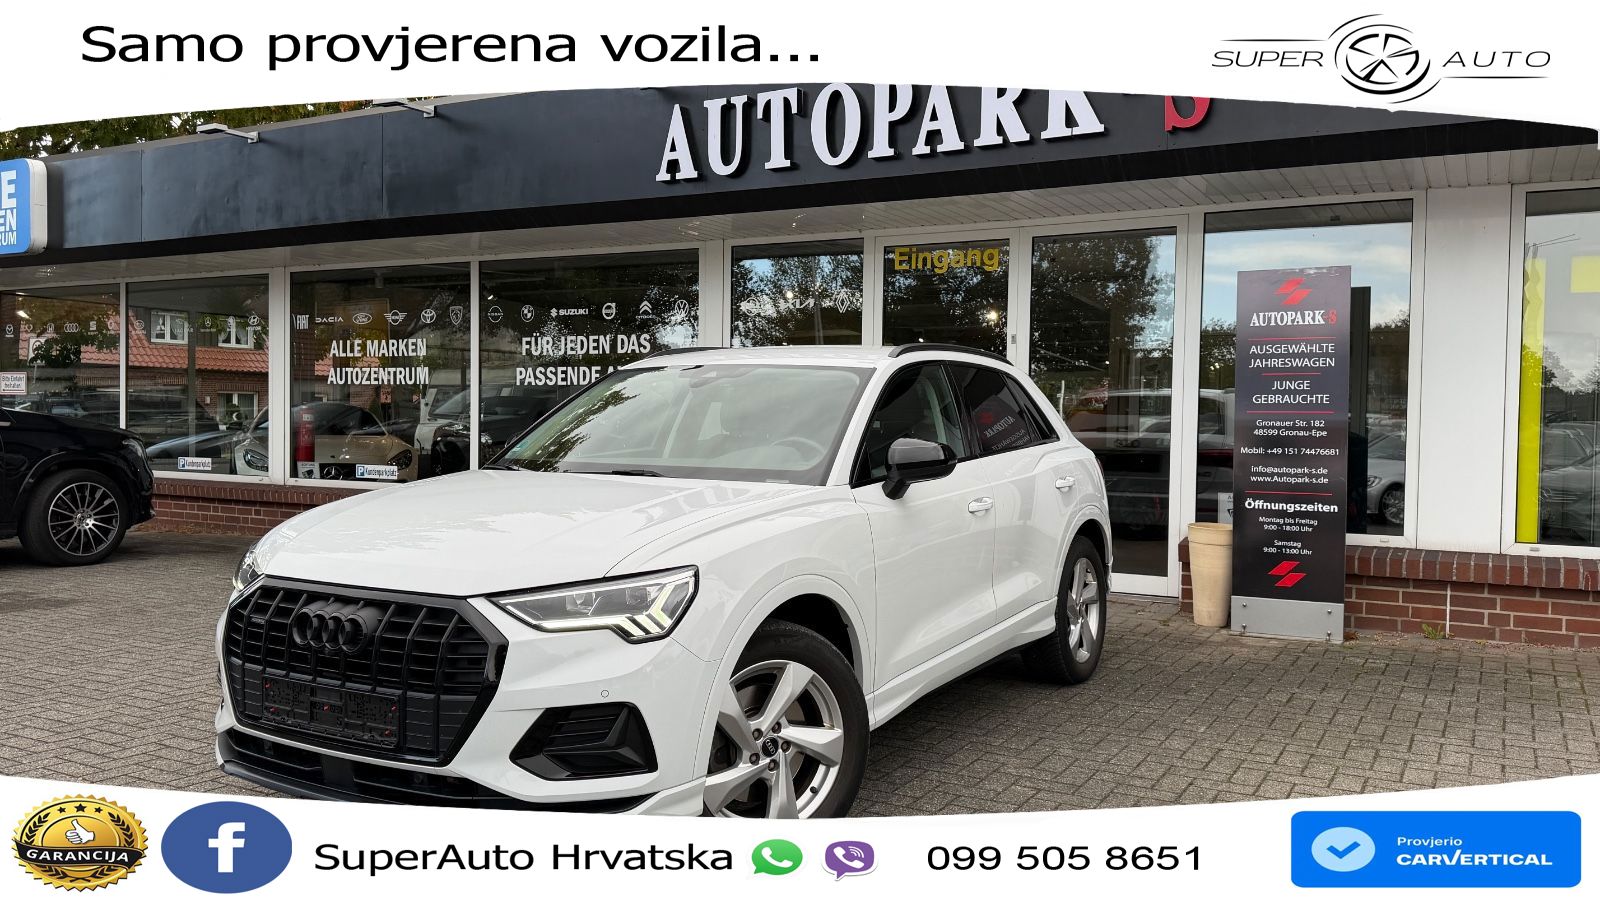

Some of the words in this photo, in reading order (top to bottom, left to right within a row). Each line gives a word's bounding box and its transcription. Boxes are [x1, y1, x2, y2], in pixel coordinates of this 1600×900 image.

[0, 231, 17, 246] UM
[894, 247, 1000, 274] Eingang
[558, 308, 588, 316] SUZUKI
[329, 339, 363, 358] ALLE
[366, 338, 427, 357] MARKEN
[521, 332, 552, 356] FÜR
[555, 335, 610, 355] JEDEN
[617, 334, 651, 354] DAS
[1249, 342, 1335, 355] AUSGEWÄHLTE
[1248, 357, 1335, 368] JAHRESWAGEN
[327, 366, 429, 385] AUTOZENTRUM
[515, 365, 602, 386] PASSENDE
[1271, 380, 1311, 390] JUNGE
[1252, 394, 1330, 404] GEBRAUCHTE
[1256, 419, 1294, 427] Gronauer
[1295, 419, 1308, 427] Str.
[1253, 428, 1278, 436] 48599
[1279, 428, 1328, 438] Gronau-Epe
[1240, 446, 1265, 455] Mobil:
[1266, 447, 1283, 455] +49
[1284, 447, 1298, 455] 151
[1300, 448, 1340, 456] 74476681
[1251, 465, 1329, 475] info@autopark-s.de
[1250, 475, 1329, 485] www.Autopark-s.de
[1244, 497, 1339, 513] Öffnungszeiten
[1258, 516, 1284, 524] Montag
[1295, 517, 1318, 526] Freitag
[1273, 539, 1302, 548] Samstag
